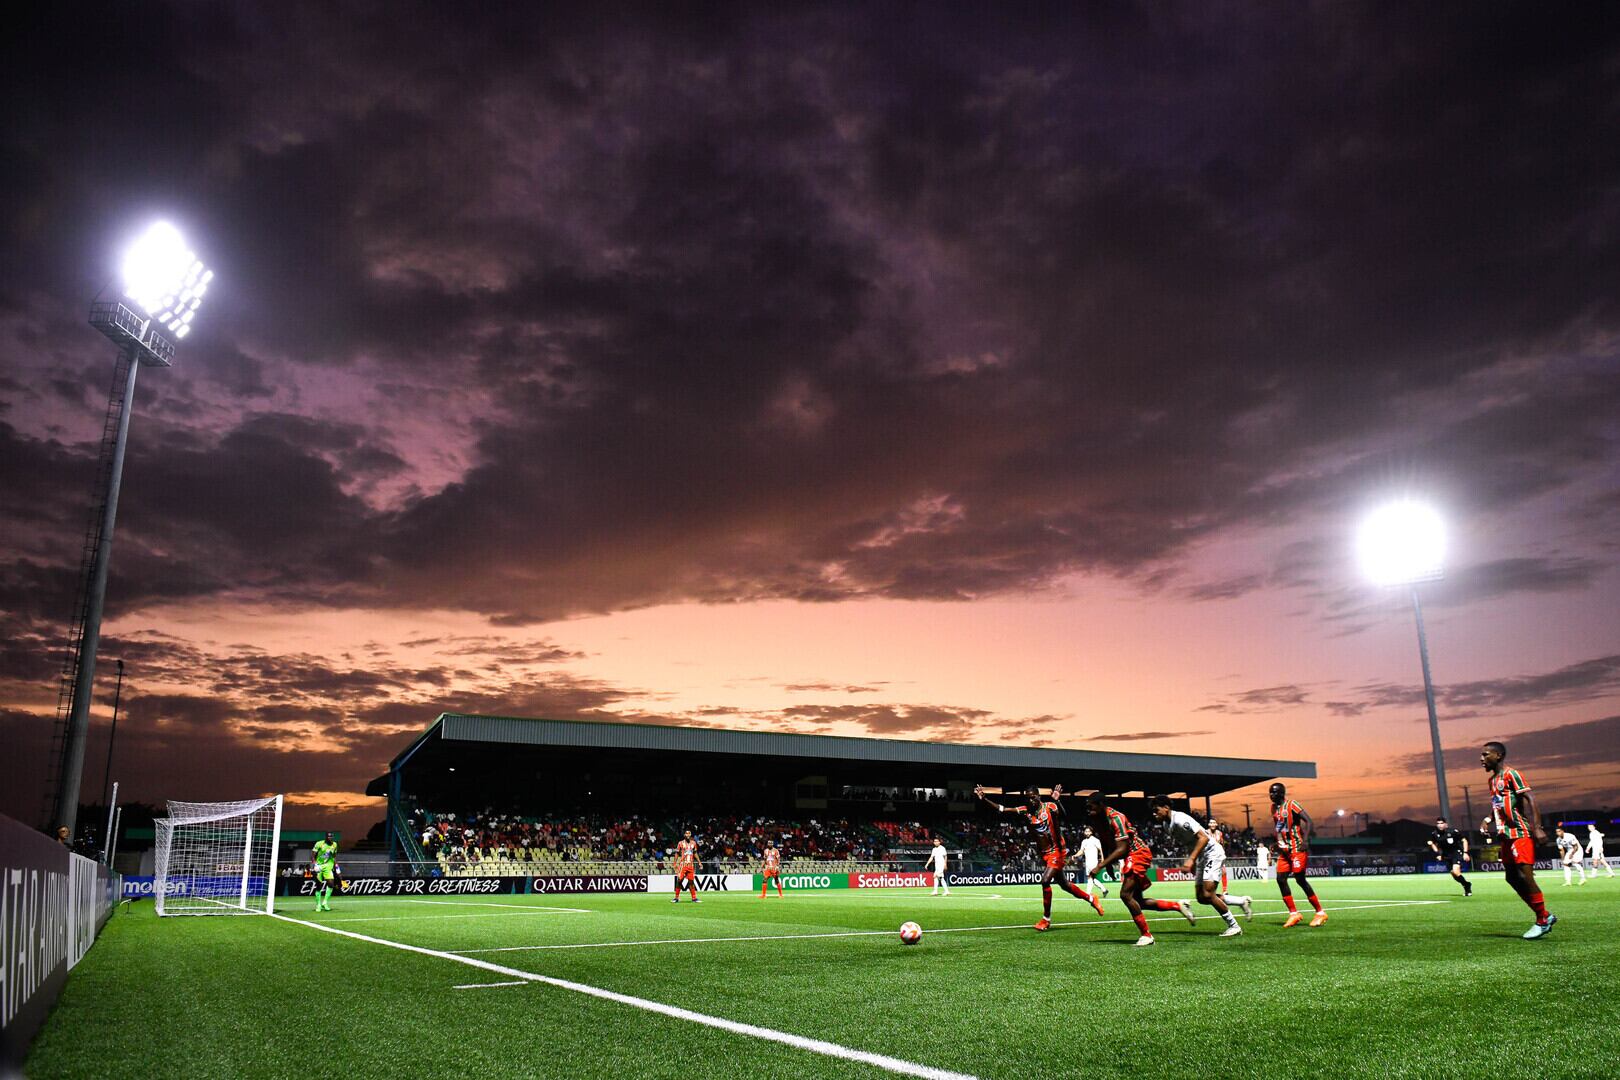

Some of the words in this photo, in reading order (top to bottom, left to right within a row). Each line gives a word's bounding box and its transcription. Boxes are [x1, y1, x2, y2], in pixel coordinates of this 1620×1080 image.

[1482, 862, 1506, 872] QATA
[858, 874, 927, 888] Scotiabank
[950, 873, 993, 885] Concacaf
[994, 873, 1055, 884] CHAMPIO
[1163, 869, 1197, 881] Scotia
[123, 880, 187, 894] molen
[341, 879, 393, 895] BATTLES
[397, 879, 424, 894] FOR
[428, 879, 500, 894] GREATNESS
[533, 878, 583, 893] QATAR
[587, 877, 647, 891] AIRWAYS
